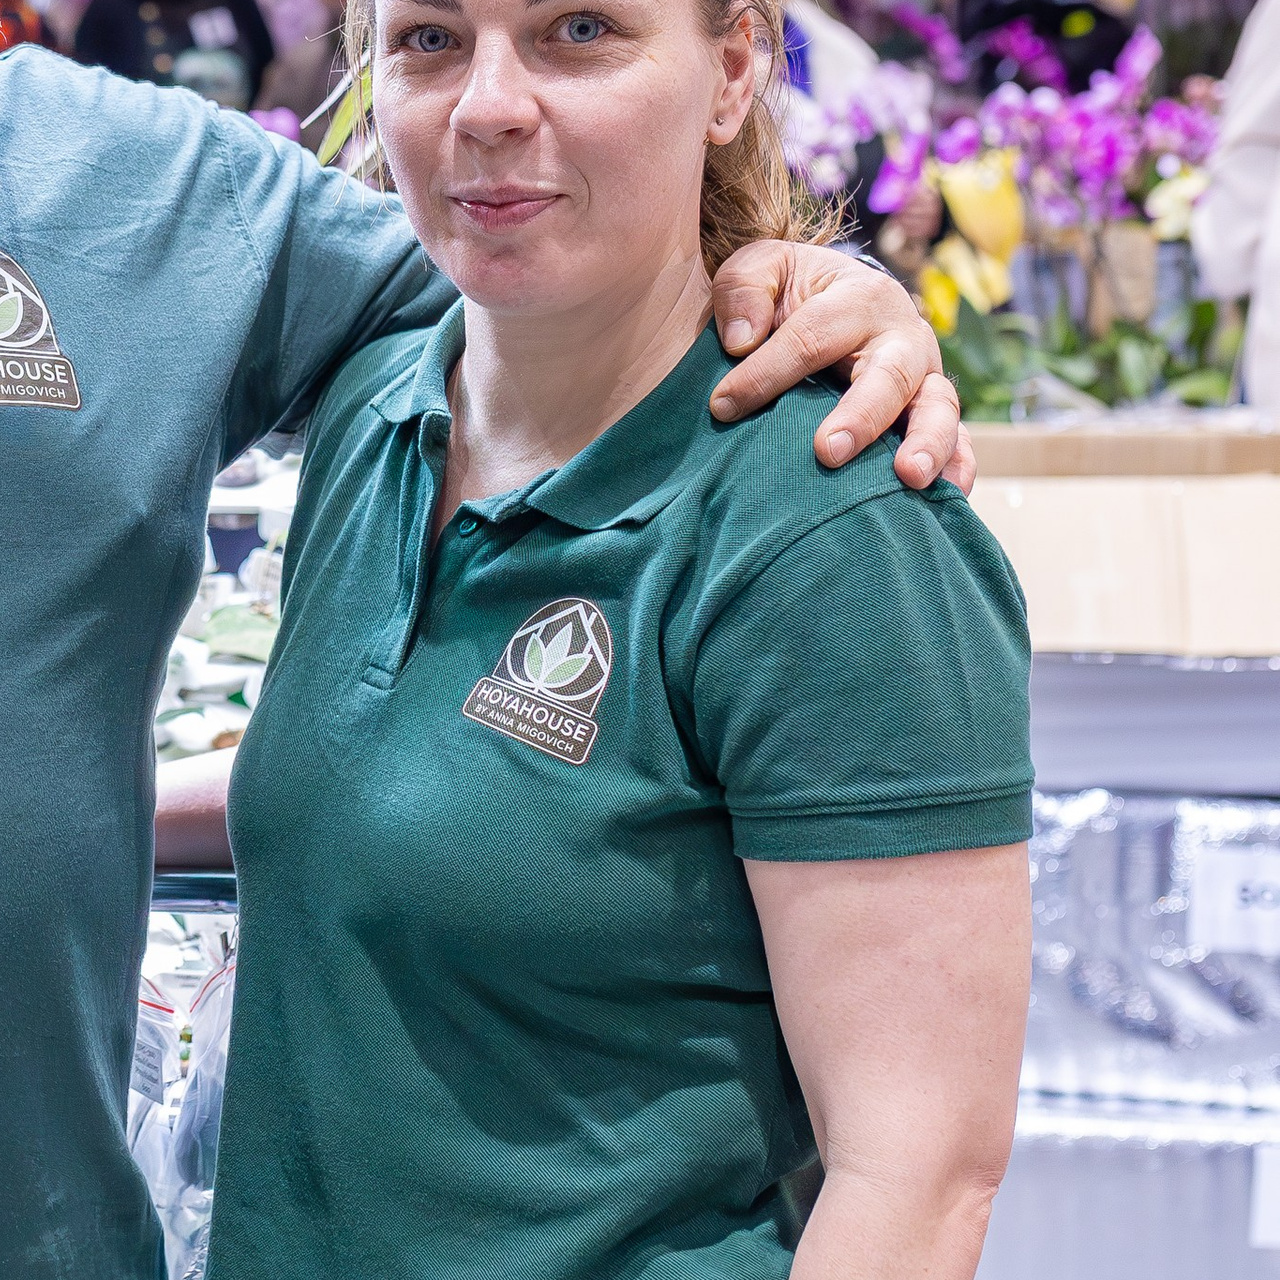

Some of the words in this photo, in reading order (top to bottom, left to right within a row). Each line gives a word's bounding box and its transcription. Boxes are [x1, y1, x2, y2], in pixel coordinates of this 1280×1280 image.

[0, 384, 66, 399] MIGOVICH
[474, 703, 488, 714] BY
[488, 708, 514, 728] ANNA
[517, 722, 575, 754] MIGOVICH
[477, 683, 590, 742] HOYAHOUSE
